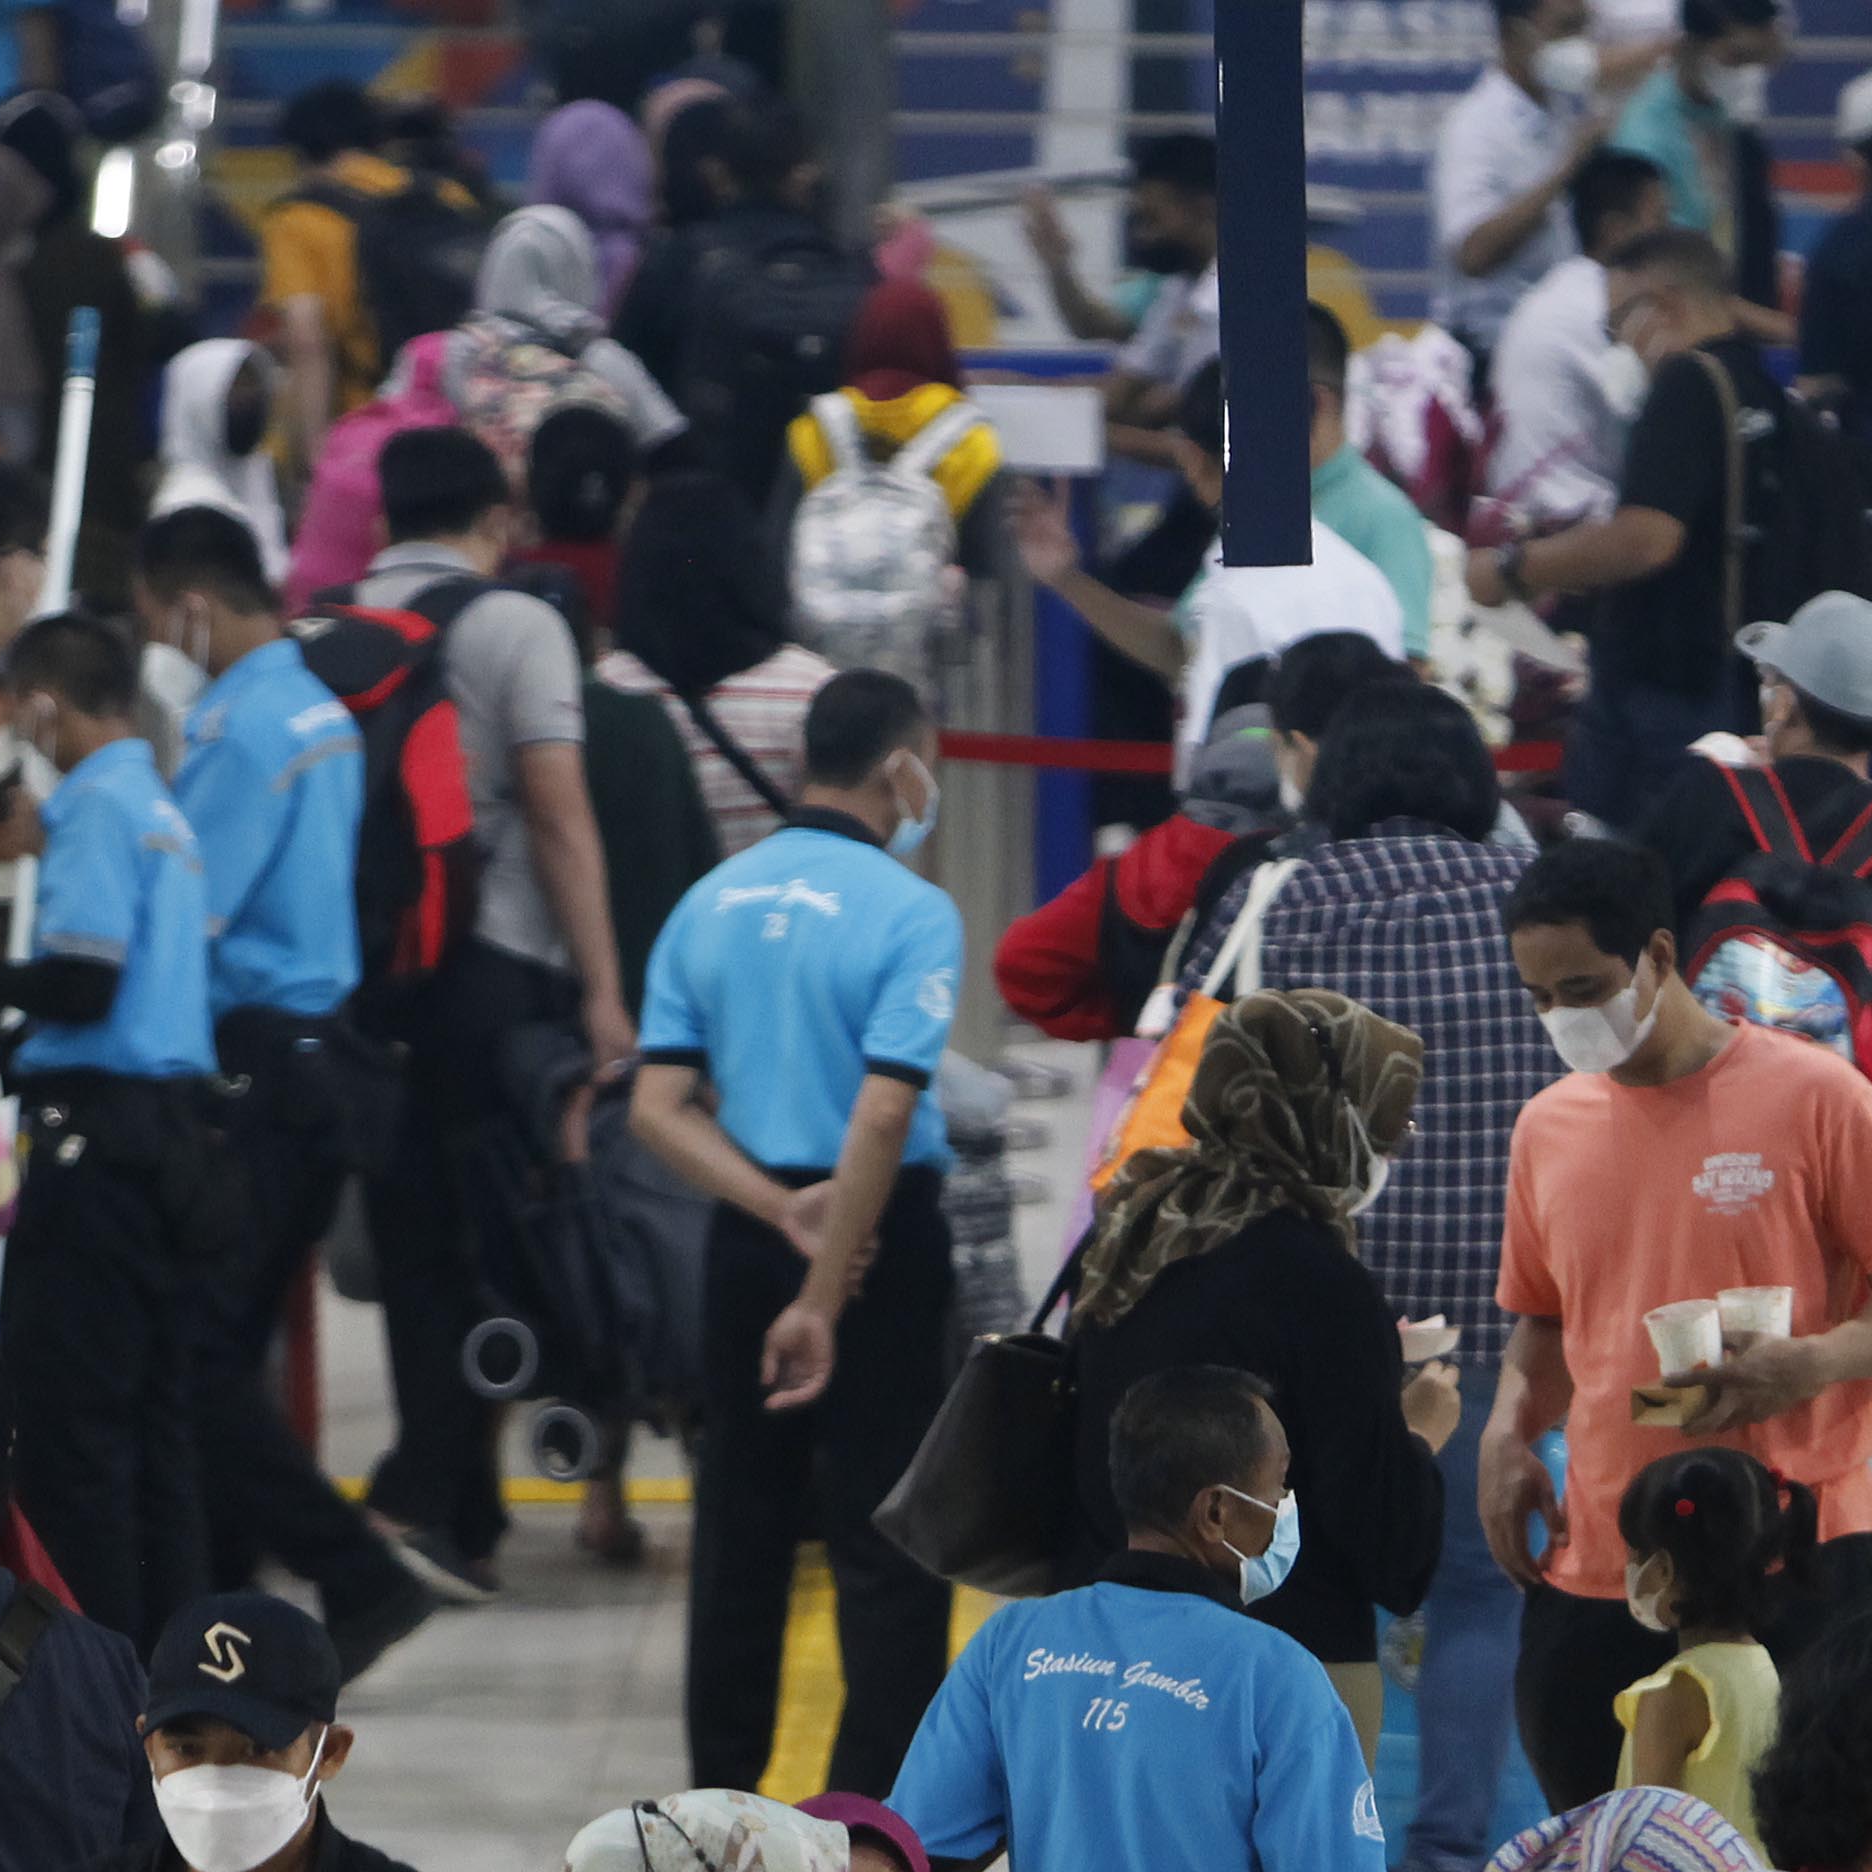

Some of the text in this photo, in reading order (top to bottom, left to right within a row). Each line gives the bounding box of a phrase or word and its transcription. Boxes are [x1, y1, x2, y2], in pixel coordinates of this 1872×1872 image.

[1024, 1648, 1210, 1710] Stasiun Gambir
[1083, 1697, 1130, 1730] 115
